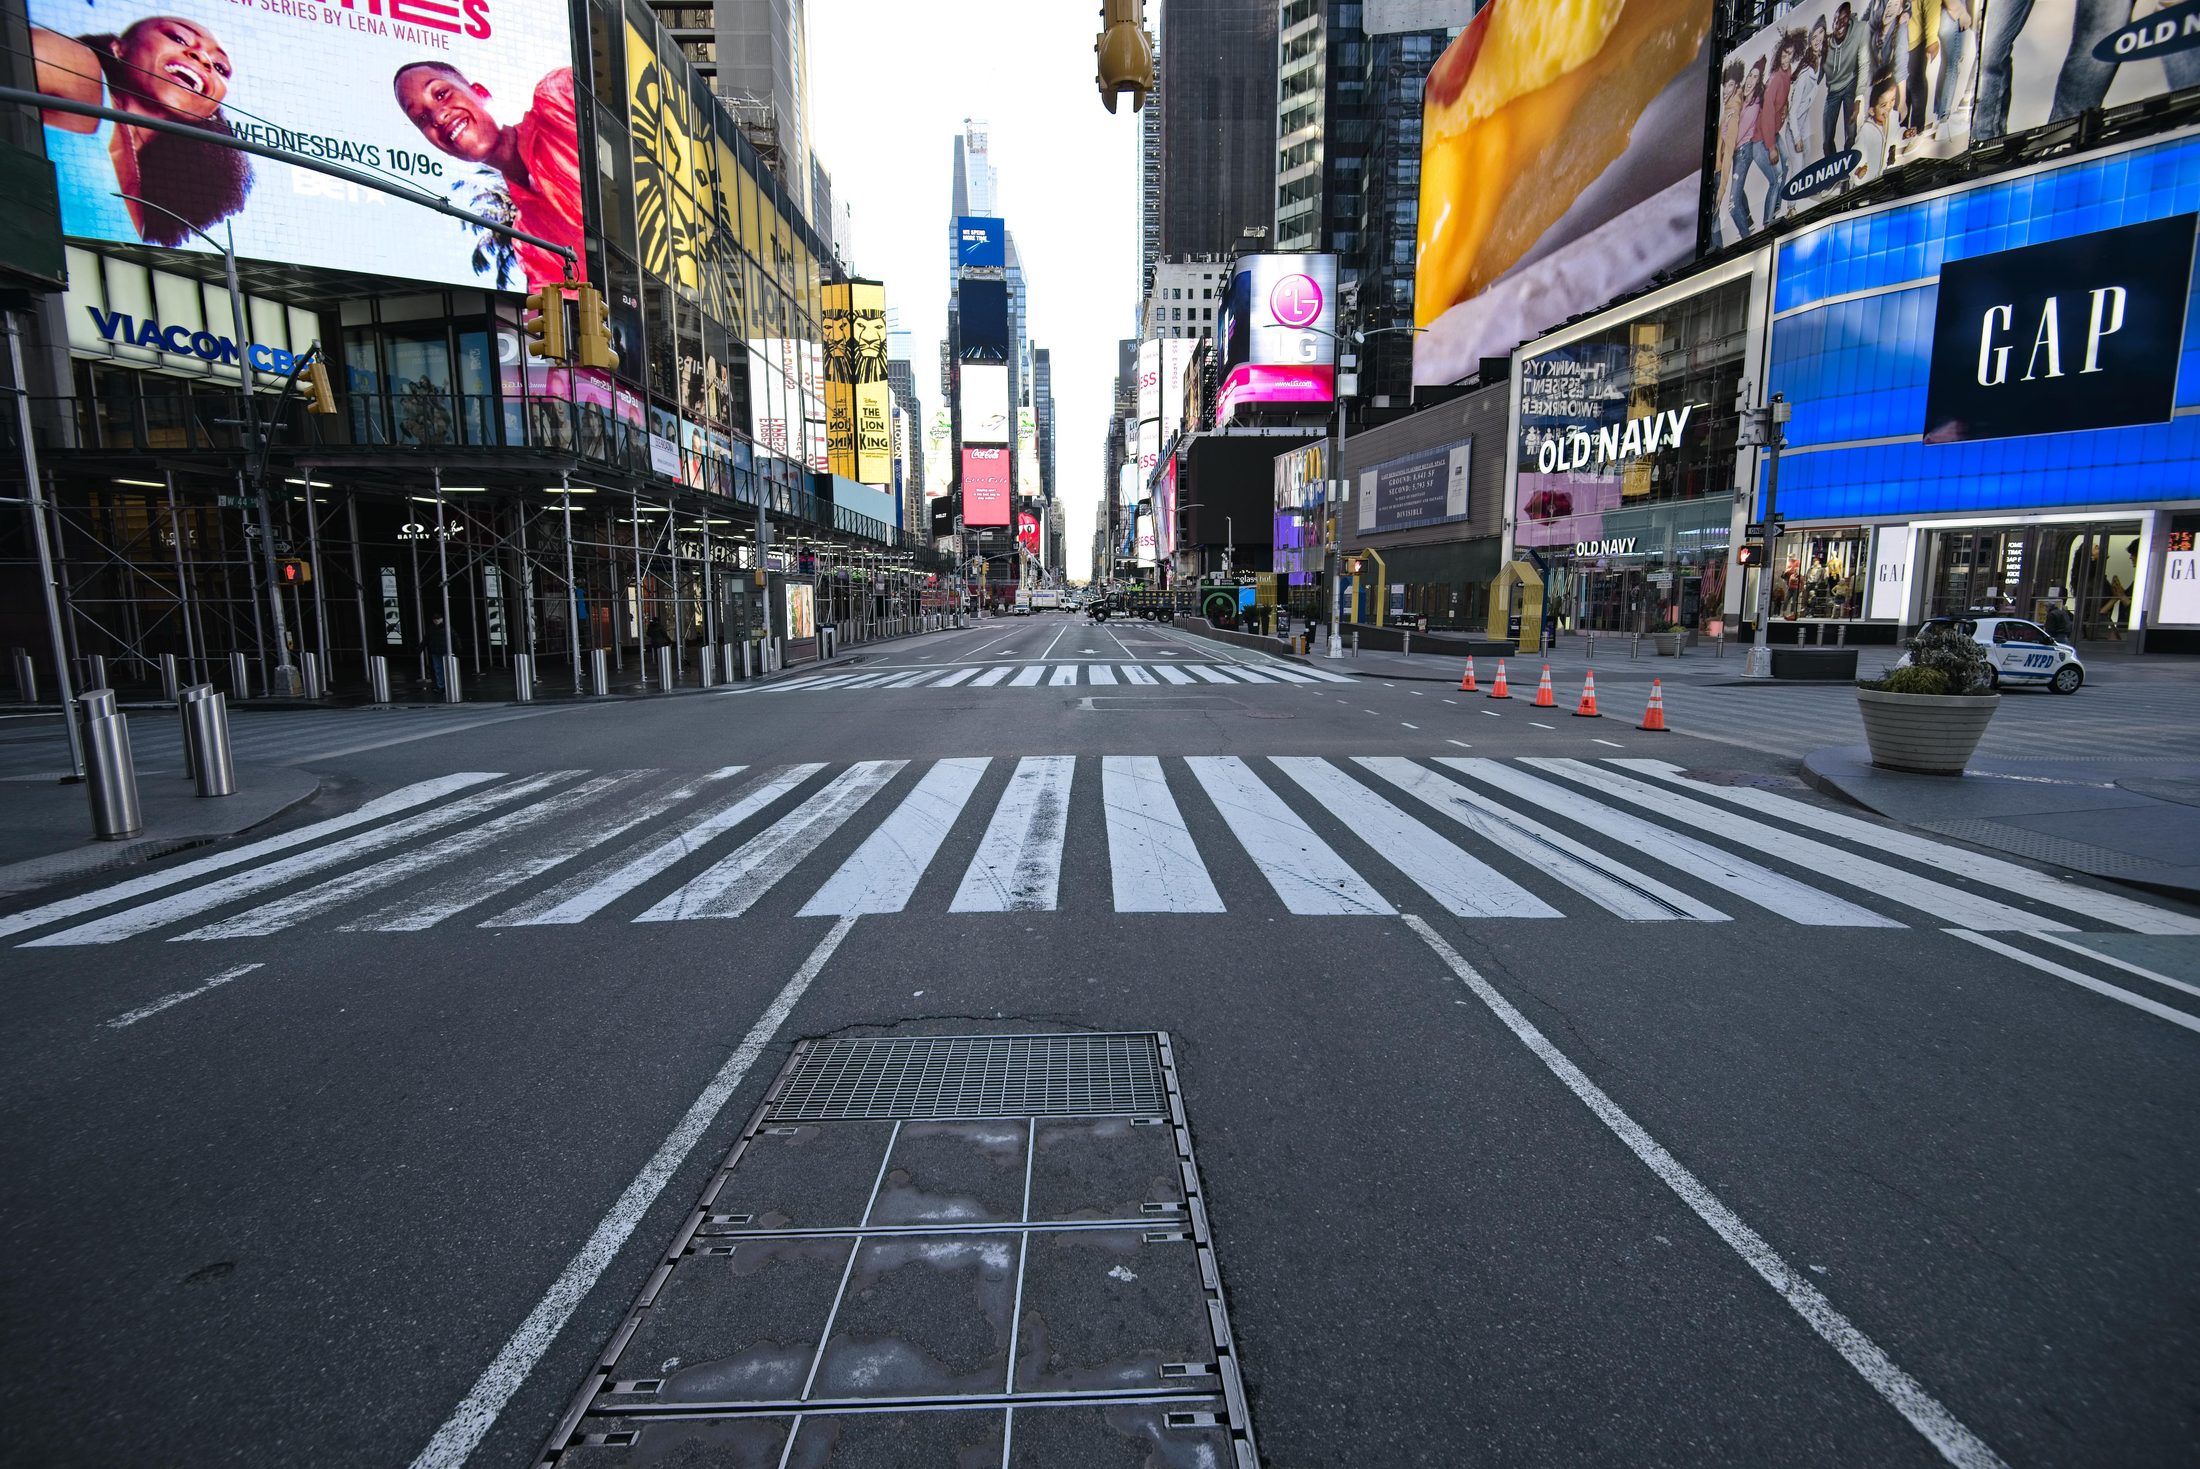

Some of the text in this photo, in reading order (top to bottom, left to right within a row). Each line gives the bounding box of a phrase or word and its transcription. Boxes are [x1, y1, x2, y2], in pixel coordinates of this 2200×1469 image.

[260, 0, 318, 21] SERIES
[323, 7, 342, 26] BY
[348, 13, 388, 37] LENA
[392, 23, 450, 51] WAITHE
[2114, 20, 2177, 55] OLD
[226, 119, 444, 178] WEDNESDAYS 10/9c
[1789, 154, 1853, 196] OLD NAVY
[1273, 332, 1318, 363] LG
[1977, 286, 2127, 387] GAP
[860, 418, 884, 433] LION
[863, 407, 880, 417] THE
[859, 433, 888, 451] KING
[894, 417, 902, 460] NOVOTEL
[1538, 432, 1592, 475] OLD
[1597, 405, 1693, 464] NAVY
[1397, 508, 1422, 518] DIVISIBLE
[1576, 537, 1637, 557] OLD NAVY
[2023, 653, 2055, 669] NYPD
